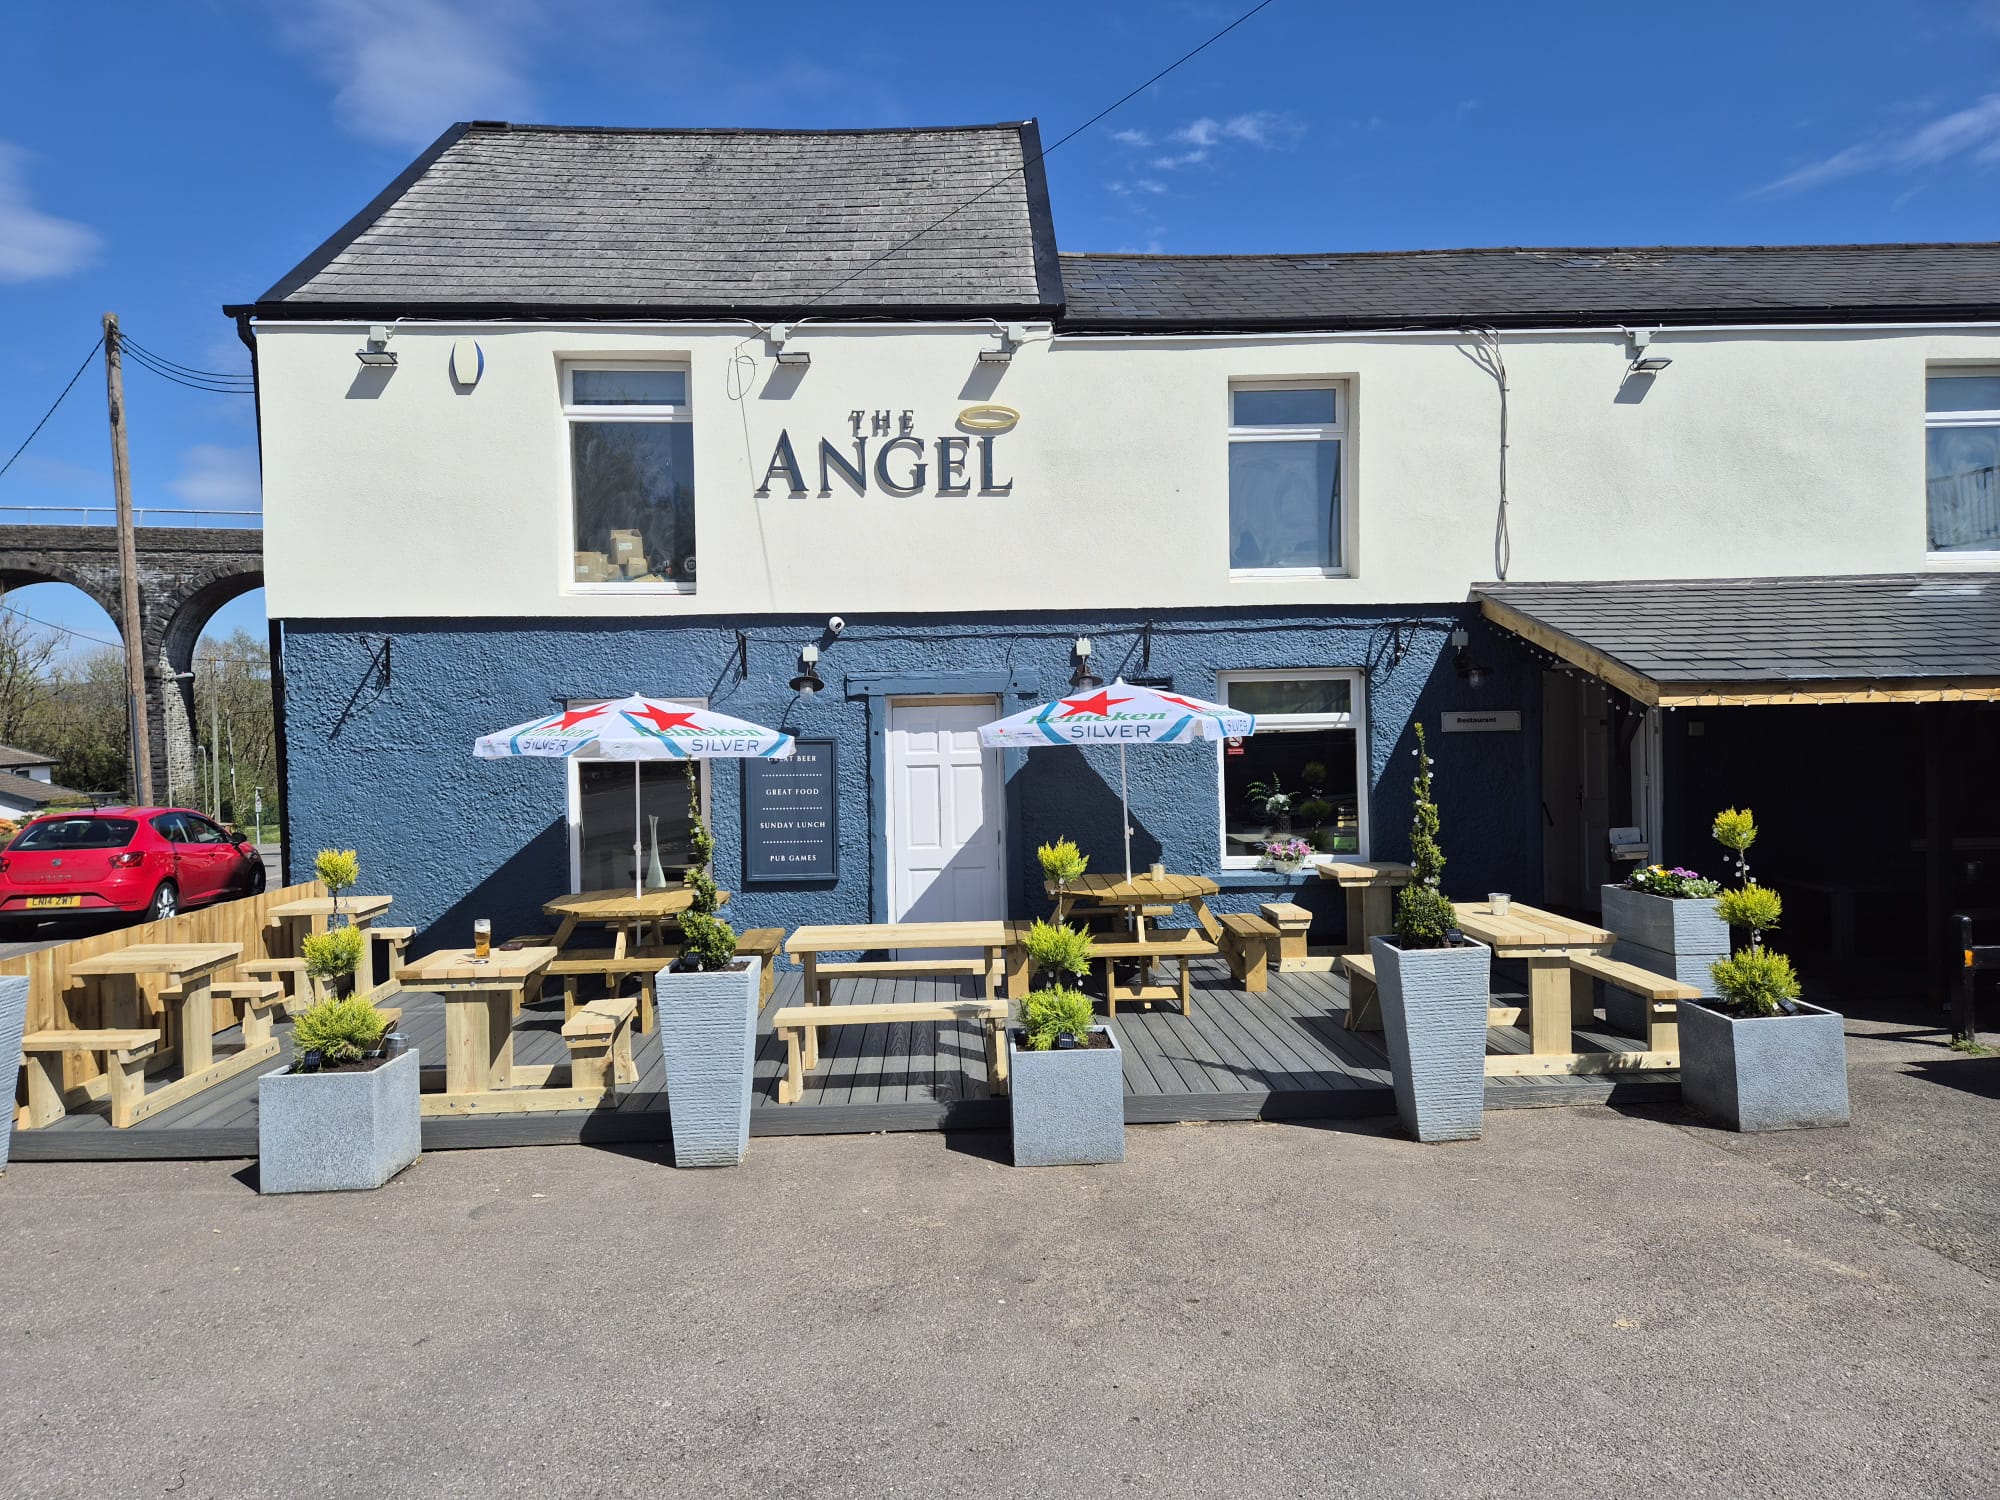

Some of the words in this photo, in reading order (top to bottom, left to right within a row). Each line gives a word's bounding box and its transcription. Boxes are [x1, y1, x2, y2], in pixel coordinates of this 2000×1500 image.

[850, 409, 914, 430] THE
[755, 428, 1013, 492] ANGEL
[1456, 716, 1497, 724] Restaurant
[1070, 725, 1151, 738] SILVER
[523, 738, 568, 752] SILVER
[691, 738, 760, 752] SILVER
[765, 788, 793, 796] GREAT
[795, 788, 820, 796] FOOD
[760, 821, 794, 829] SUNDAY
[788, 854, 817, 862] GAMES
